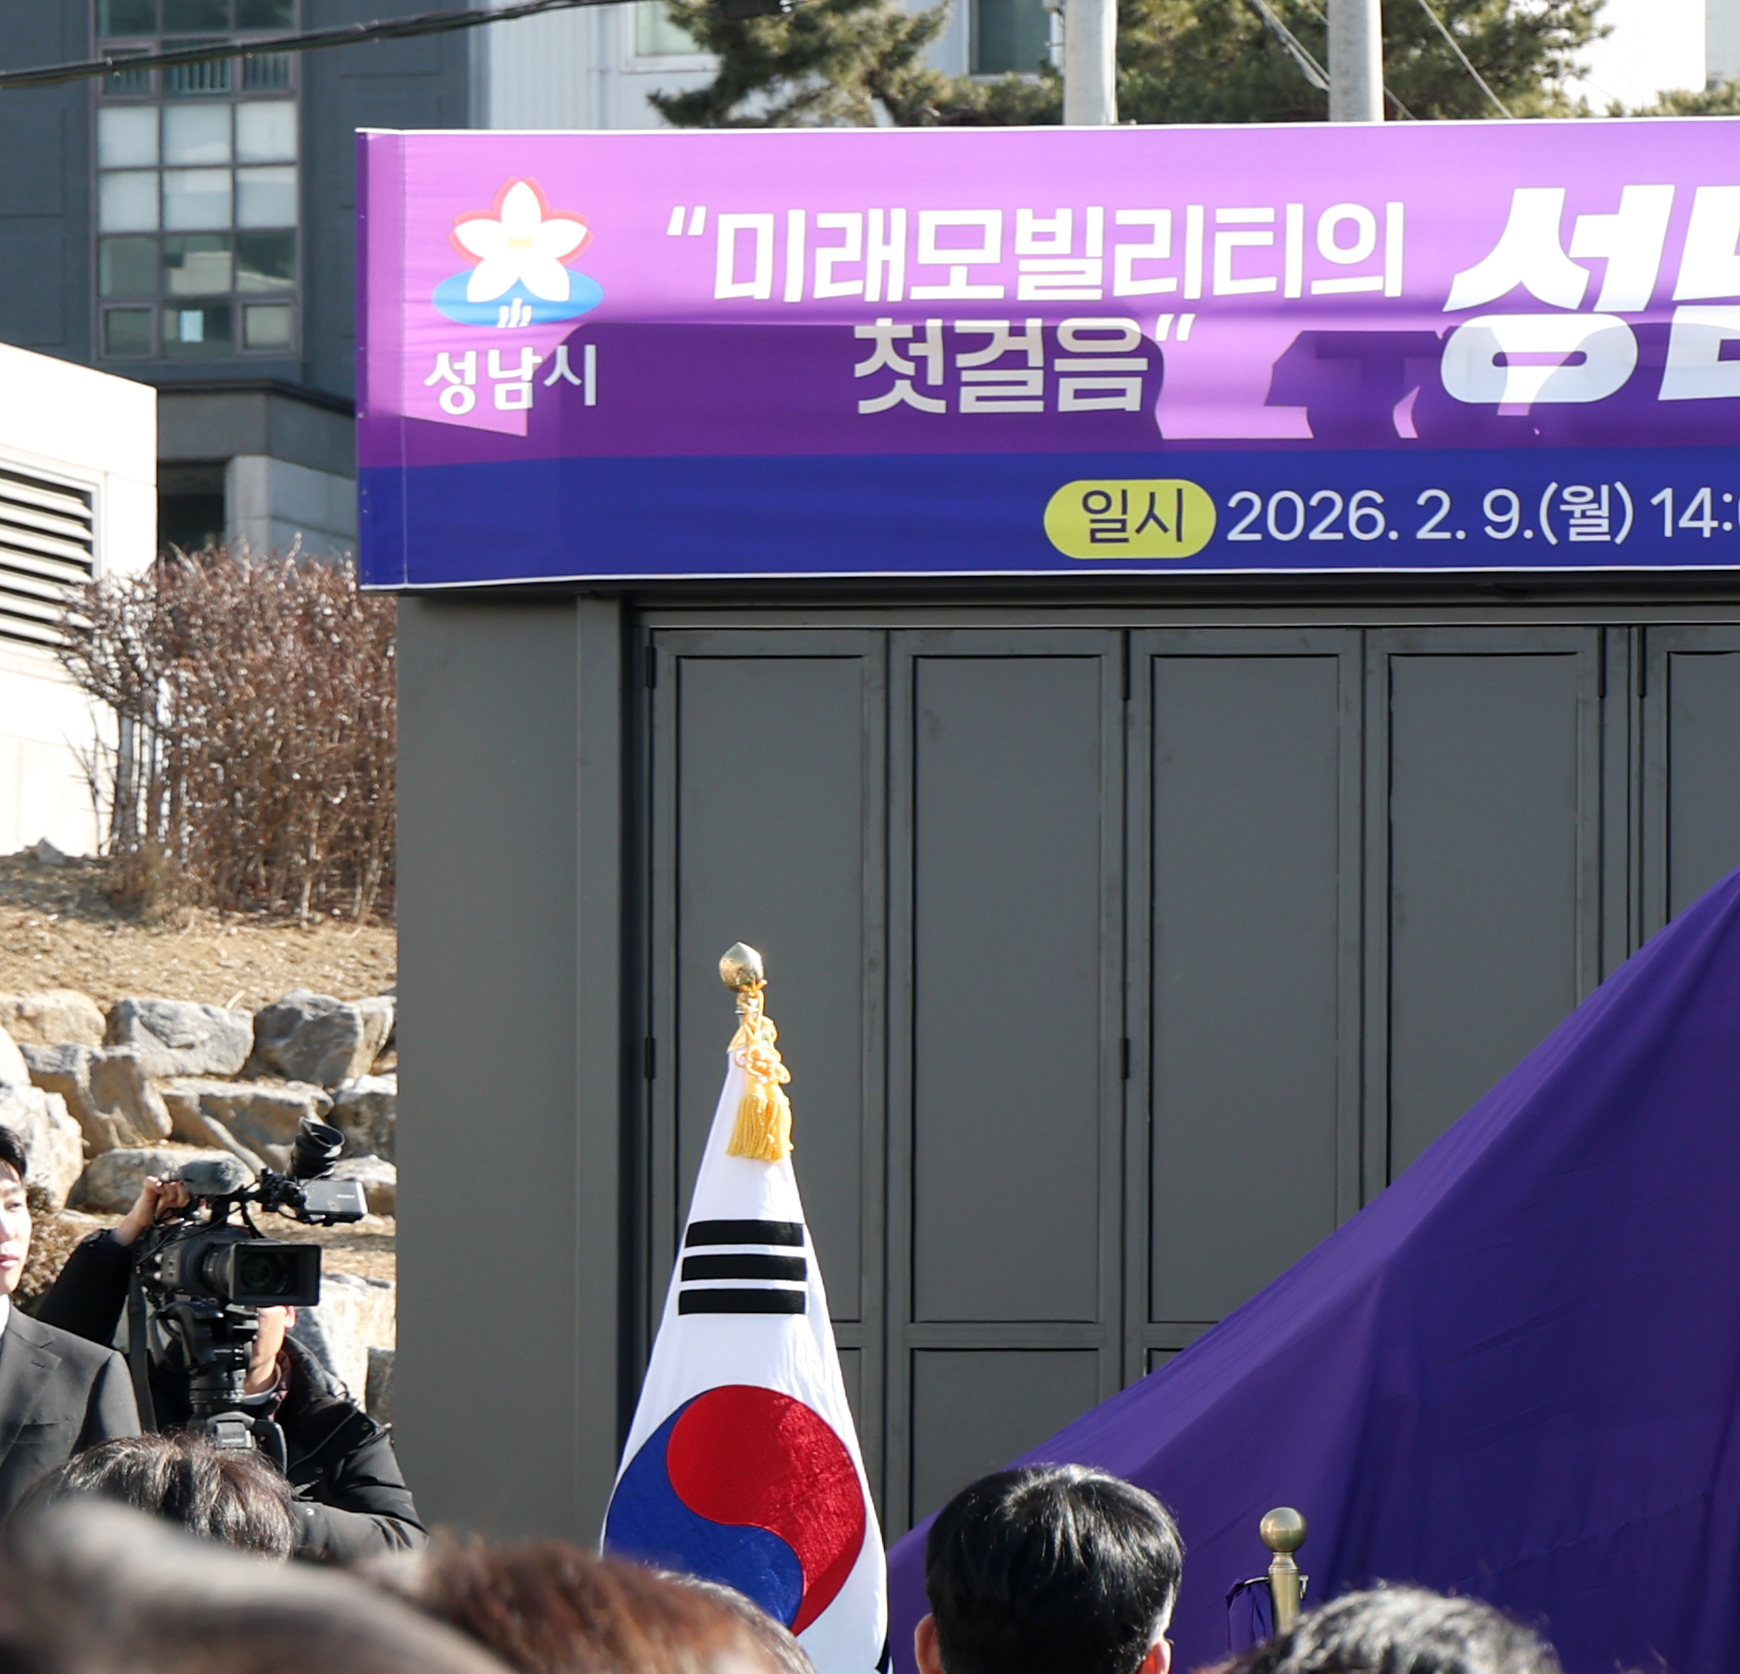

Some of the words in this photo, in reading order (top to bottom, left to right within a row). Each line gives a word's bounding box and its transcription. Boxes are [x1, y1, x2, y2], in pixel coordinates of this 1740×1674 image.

[423, 345, 598, 415] 성남시
[1082, 488, 1183, 544] 일시
[1228, 490, 1399, 542] 2026.
[1416, 490, 1466, 542] 2.
[1483, 485, 1634, 544] 9.(월)
